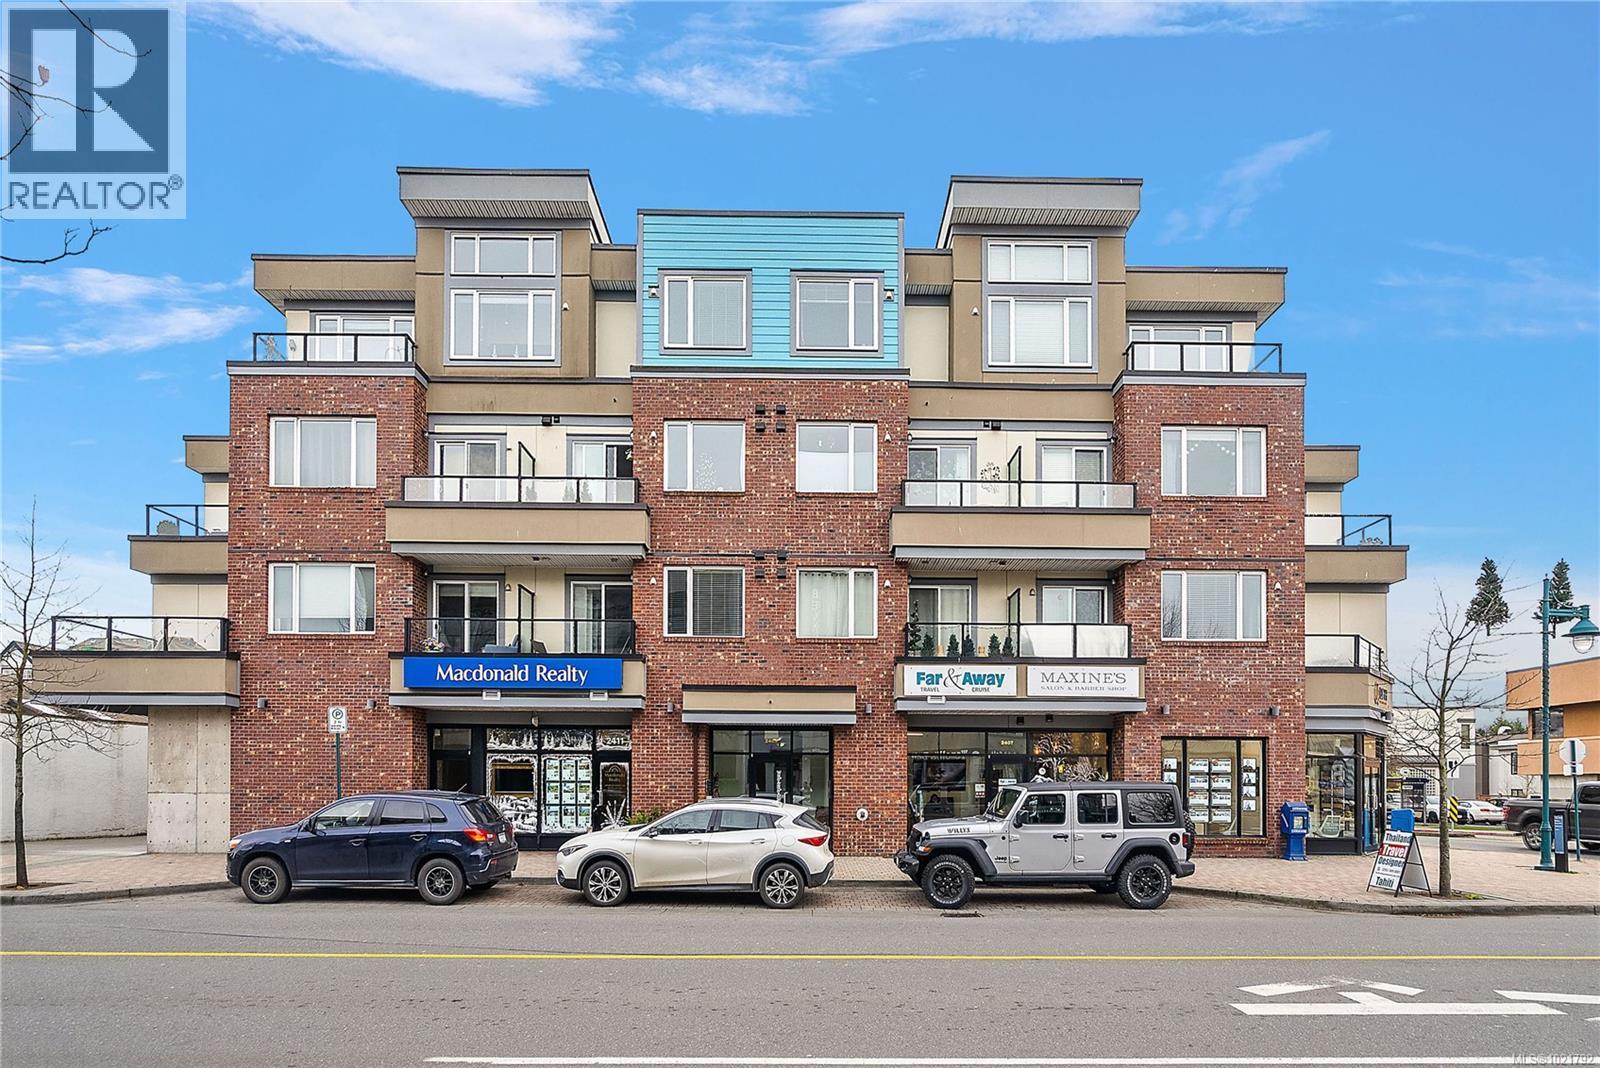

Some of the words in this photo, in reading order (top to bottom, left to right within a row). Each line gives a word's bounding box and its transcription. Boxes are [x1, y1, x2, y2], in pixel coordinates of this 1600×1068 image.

[436, 664, 529, 682] Macdonald
[536, 664, 588, 686] Realty
[916, 671, 943, 686] Far
[943, 668, 965, 691] &
[962, 671, 1006, 688] Away
[1041, 672, 1127, 684] MAXINE'S
[606, 737, 625, 745] 2411
[1382, 844, 1408, 857] Travel
[1378, 857, 1405, 868] Designer
[1376, 876, 1394, 887] Tahiti
